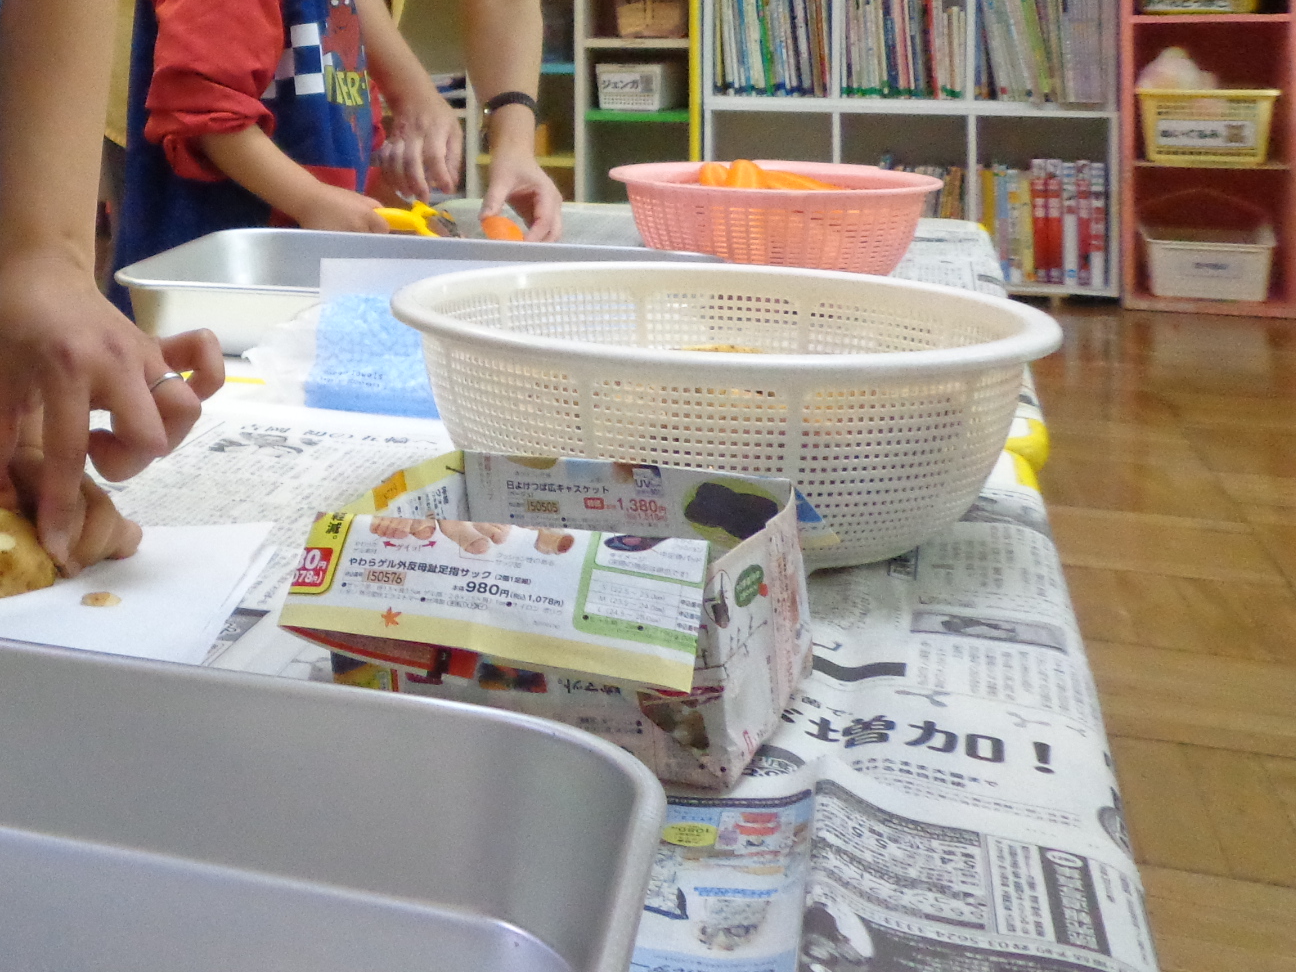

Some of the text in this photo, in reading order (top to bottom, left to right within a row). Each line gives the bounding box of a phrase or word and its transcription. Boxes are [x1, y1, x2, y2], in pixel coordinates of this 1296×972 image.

[506, 480, 610, 494] 日よけつば広キャスケット
[349, 557, 492, 579] やわらゲル外反母趾足指サック
[366, 569, 404, 584] 150576
